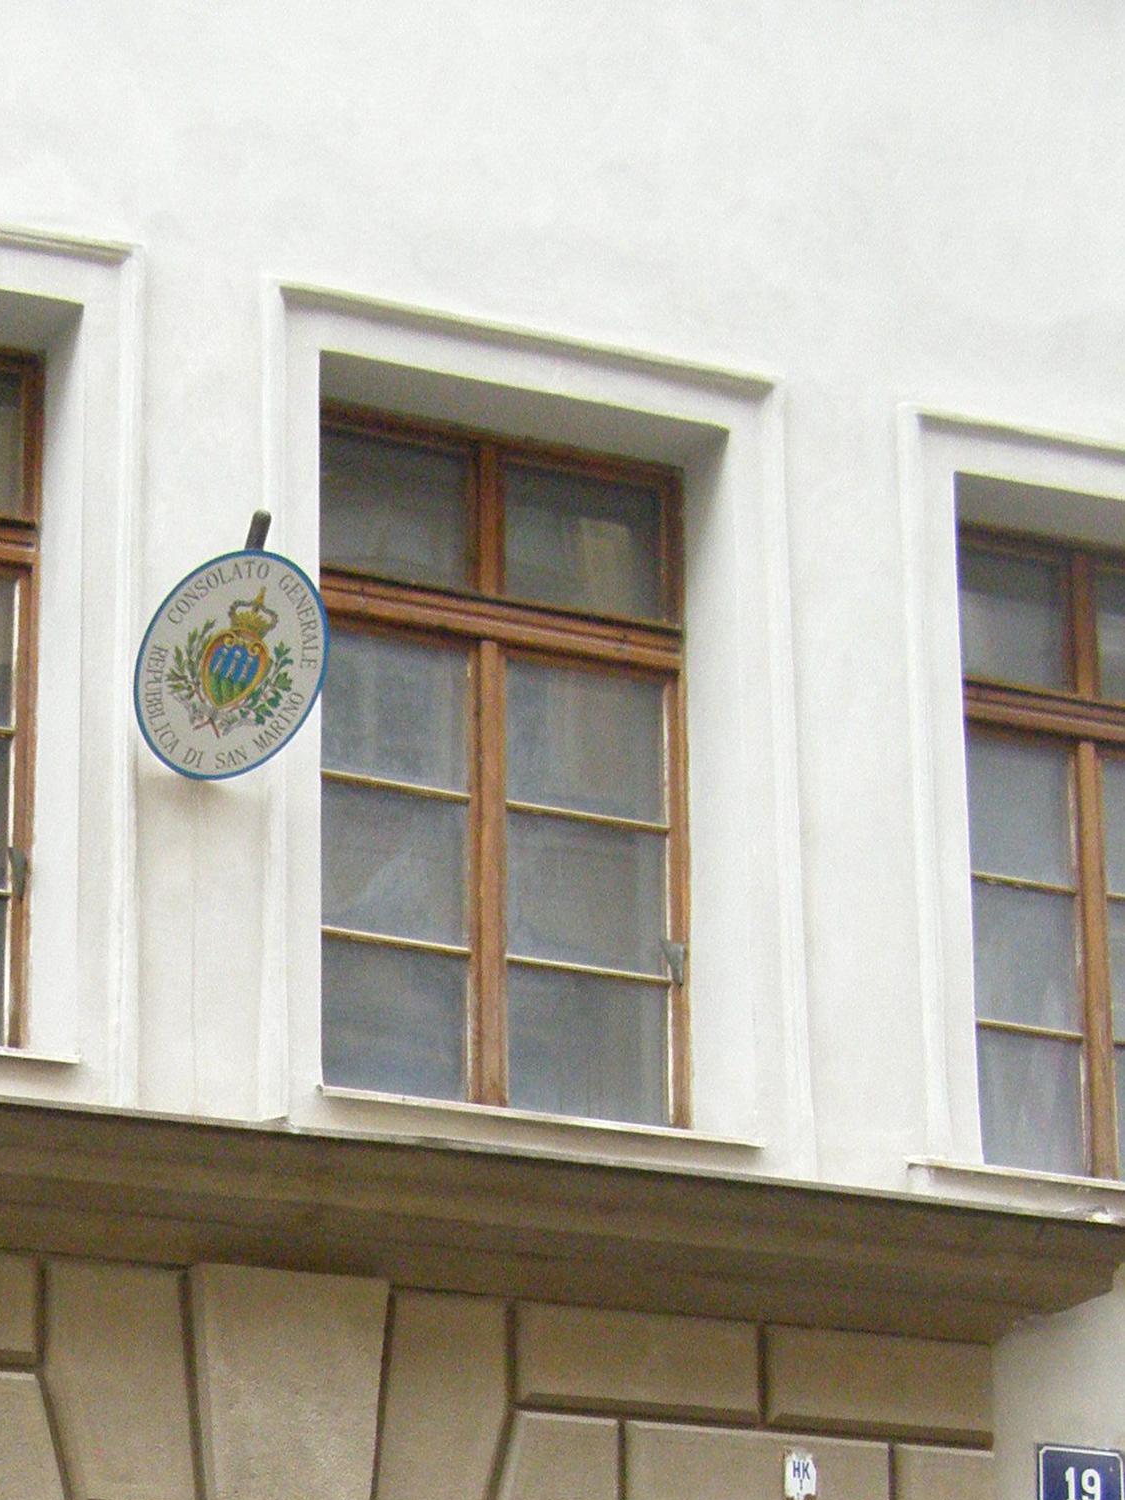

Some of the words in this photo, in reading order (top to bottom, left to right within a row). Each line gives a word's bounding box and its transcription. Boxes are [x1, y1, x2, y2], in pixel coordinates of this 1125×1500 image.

[166, 559, 271, 626] CONSOLATO
[278, 574, 318, 671] GENERALE
[146, 646, 180, 756] REPUBBLICA
[181, 748, 204, 769] DI
[214, 749, 249, 771] SAN
[251, 692, 305, 753] MARINO
[792, 1460, 811, 1480] HK
